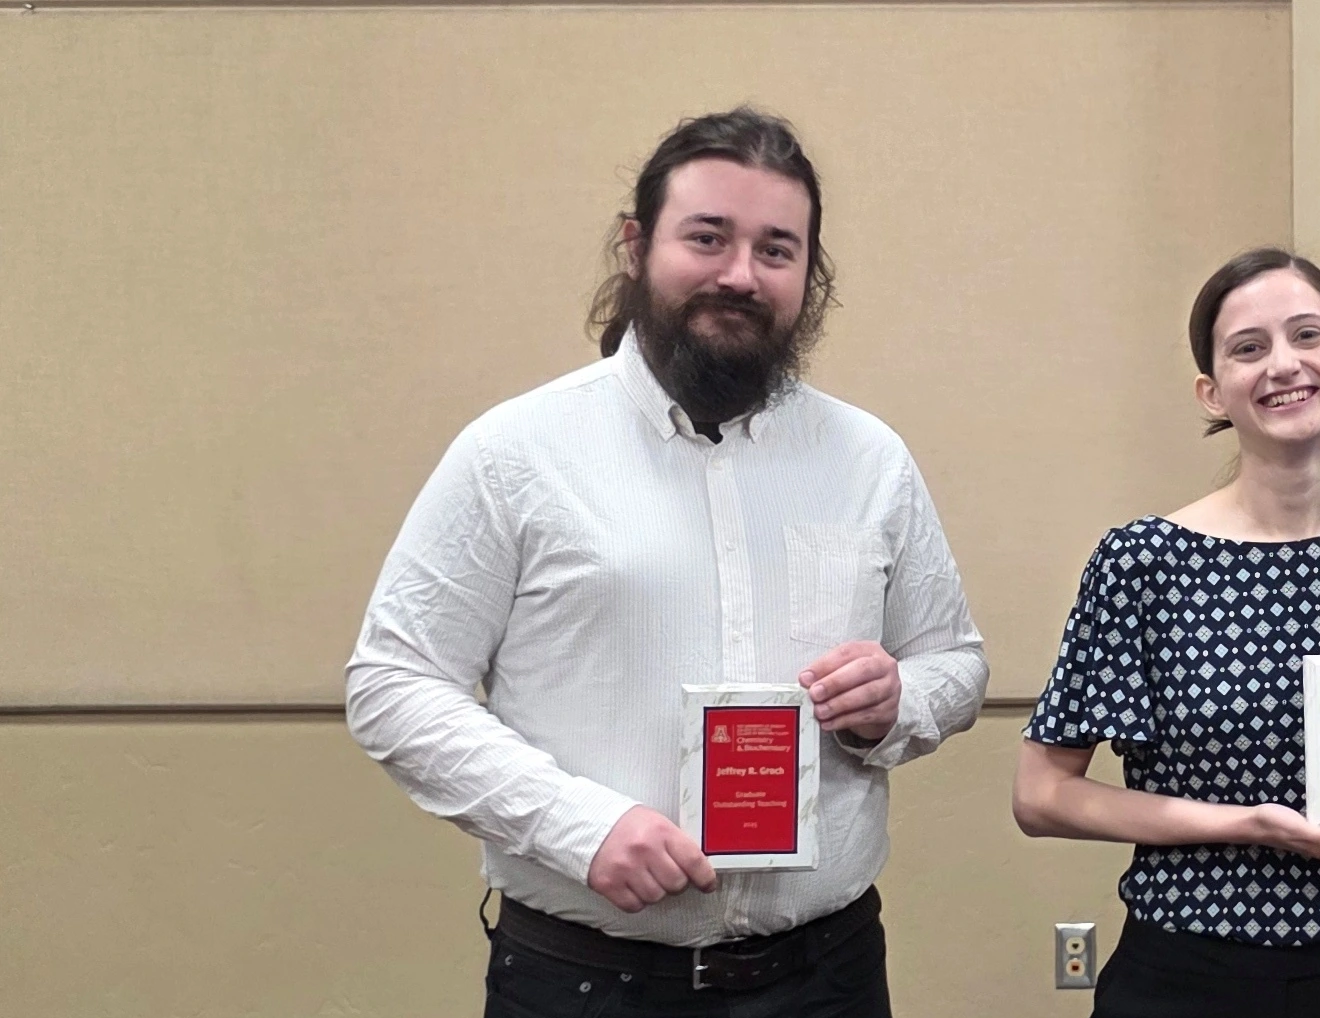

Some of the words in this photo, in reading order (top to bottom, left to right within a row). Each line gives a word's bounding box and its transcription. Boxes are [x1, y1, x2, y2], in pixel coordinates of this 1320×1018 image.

[737, 737, 773, 745] Chemistry
[744, 745, 791, 753] Biochemistry
[716, 767, 747, 777] Jeffrey
[748, 767, 757, 775] R.
[713, 800, 755, 808] Outstanding
[757, 800, 787, 808] Teaching
